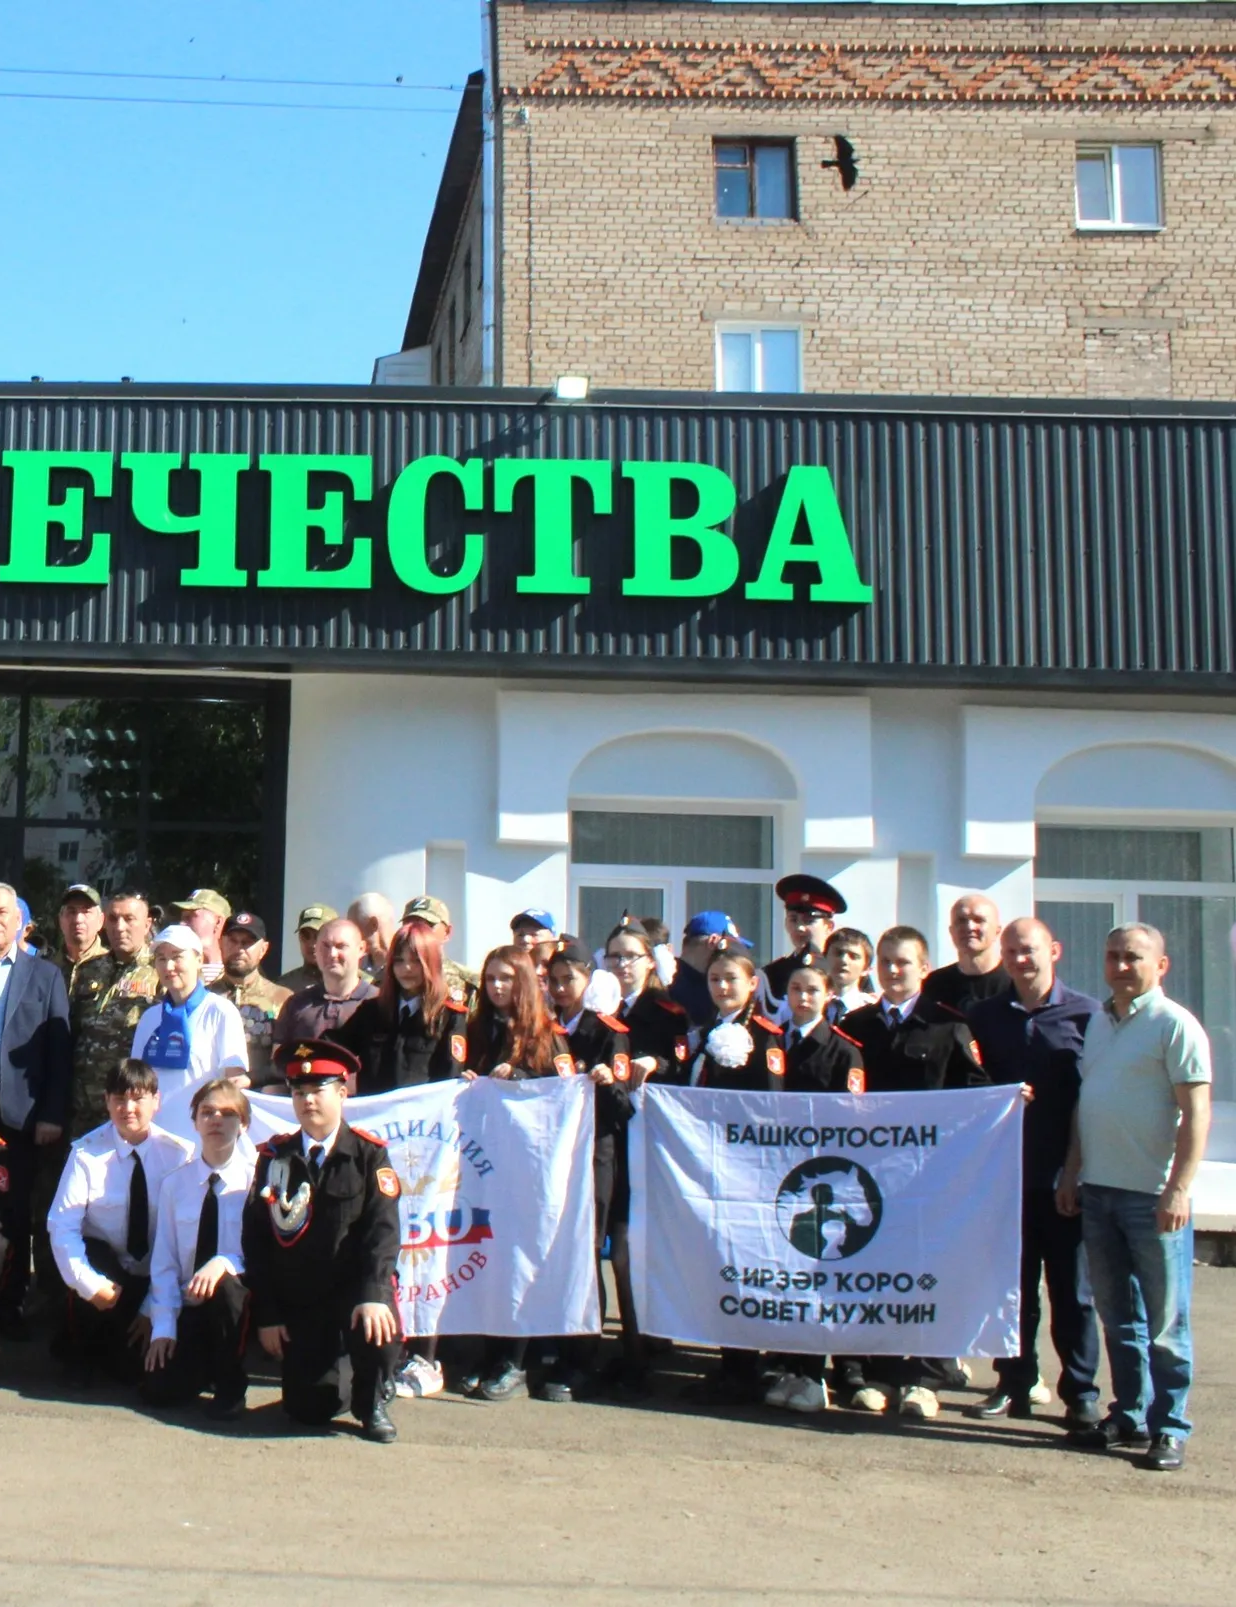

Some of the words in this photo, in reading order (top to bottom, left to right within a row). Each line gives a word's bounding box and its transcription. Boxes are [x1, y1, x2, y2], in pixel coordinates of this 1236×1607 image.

[725, 1122, 938, 1149] БАШКОРТОСТАН
[396, 1195, 473, 1245] ВО
[396, 1250, 488, 1303] ЕРАНОВ
[719, 1294, 811, 1324] СОВЕТ
[819, 1302, 937, 1326] МУЖЧИН
